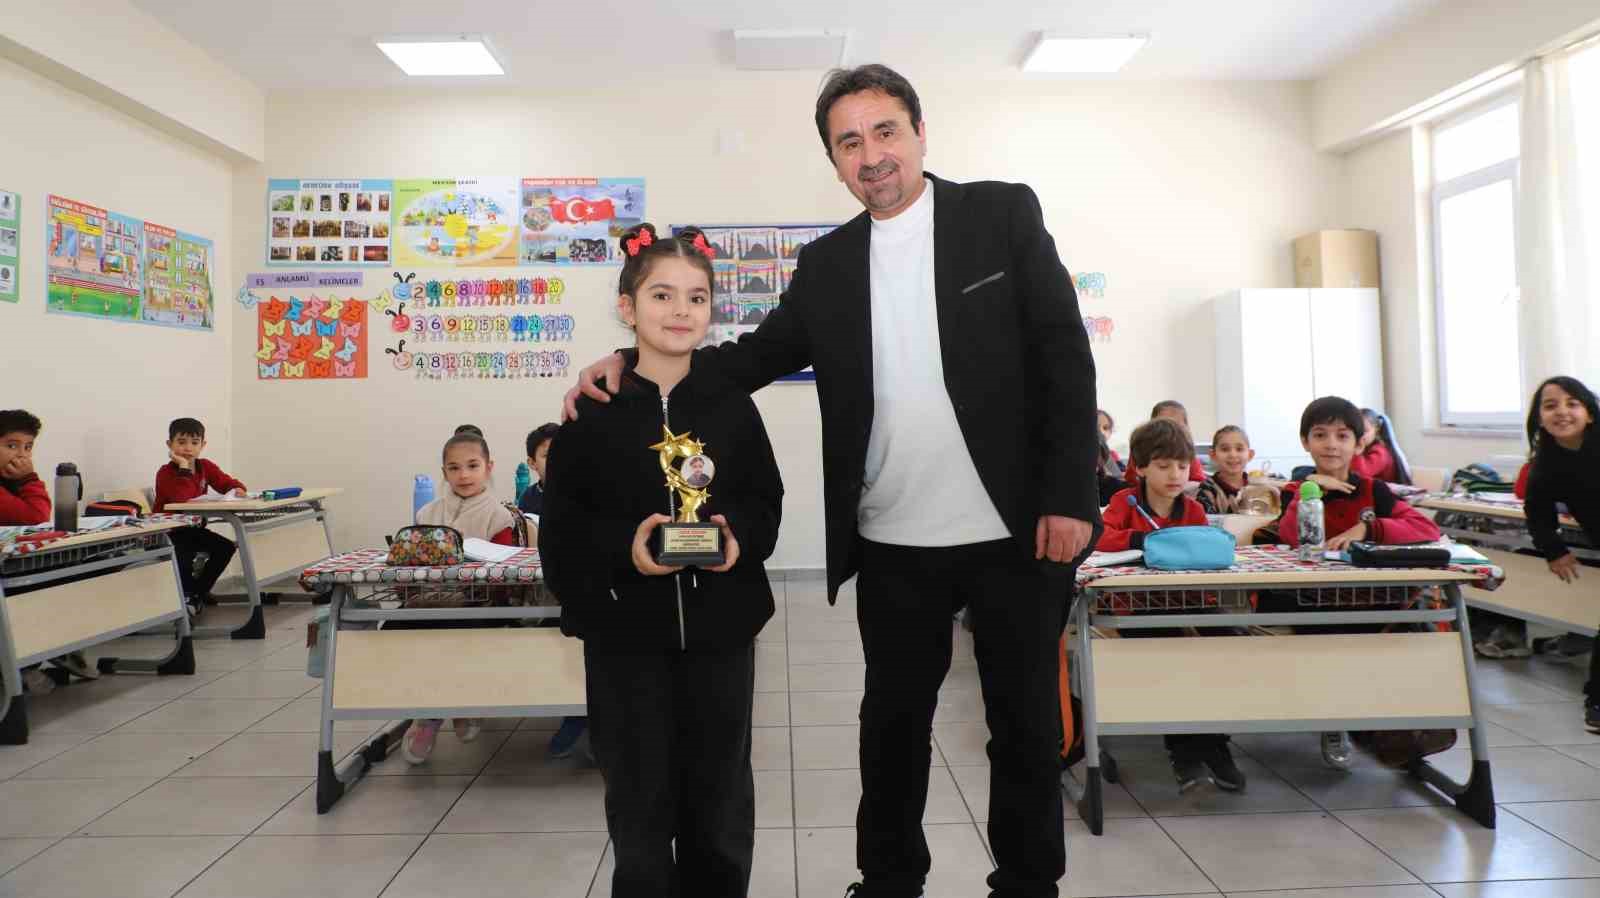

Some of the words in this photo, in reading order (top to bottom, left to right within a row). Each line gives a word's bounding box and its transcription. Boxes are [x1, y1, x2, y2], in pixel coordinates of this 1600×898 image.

[414, 286, 424, 299] 2
[430, 284, 438, 294] 4
[444, 284, 454, 296] 6
[459, 283, 469, 296] 8
[489, 284, 500, 295] 12
[520, 282, 529, 294] 16
[535, 282, 544, 294] 18
[549, 281, 559, 293] 20
[415, 319, 424, 332] 3
[431, 318, 441, 330] 6
[447, 318, 457, 331] 9
[463, 319, 473, 331] 12
[479, 319, 489, 331] 15
[496, 319, 506, 331] 18
[513, 319, 523, 331] 21
[529, 319, 539, 331] 24
[560, 318, 570, 331] 30
[415, 356, 425, 369] 4
[431, 356, 441, 368] 8
[447, 357, 456, 369] 12
[463, 356, 472, 368] 16
[477, 357, 487, 368] 20
[494, 356, 504, 368] 24
[541, 357, 551, 368] 36
[555, 354, 565, 366] 40
